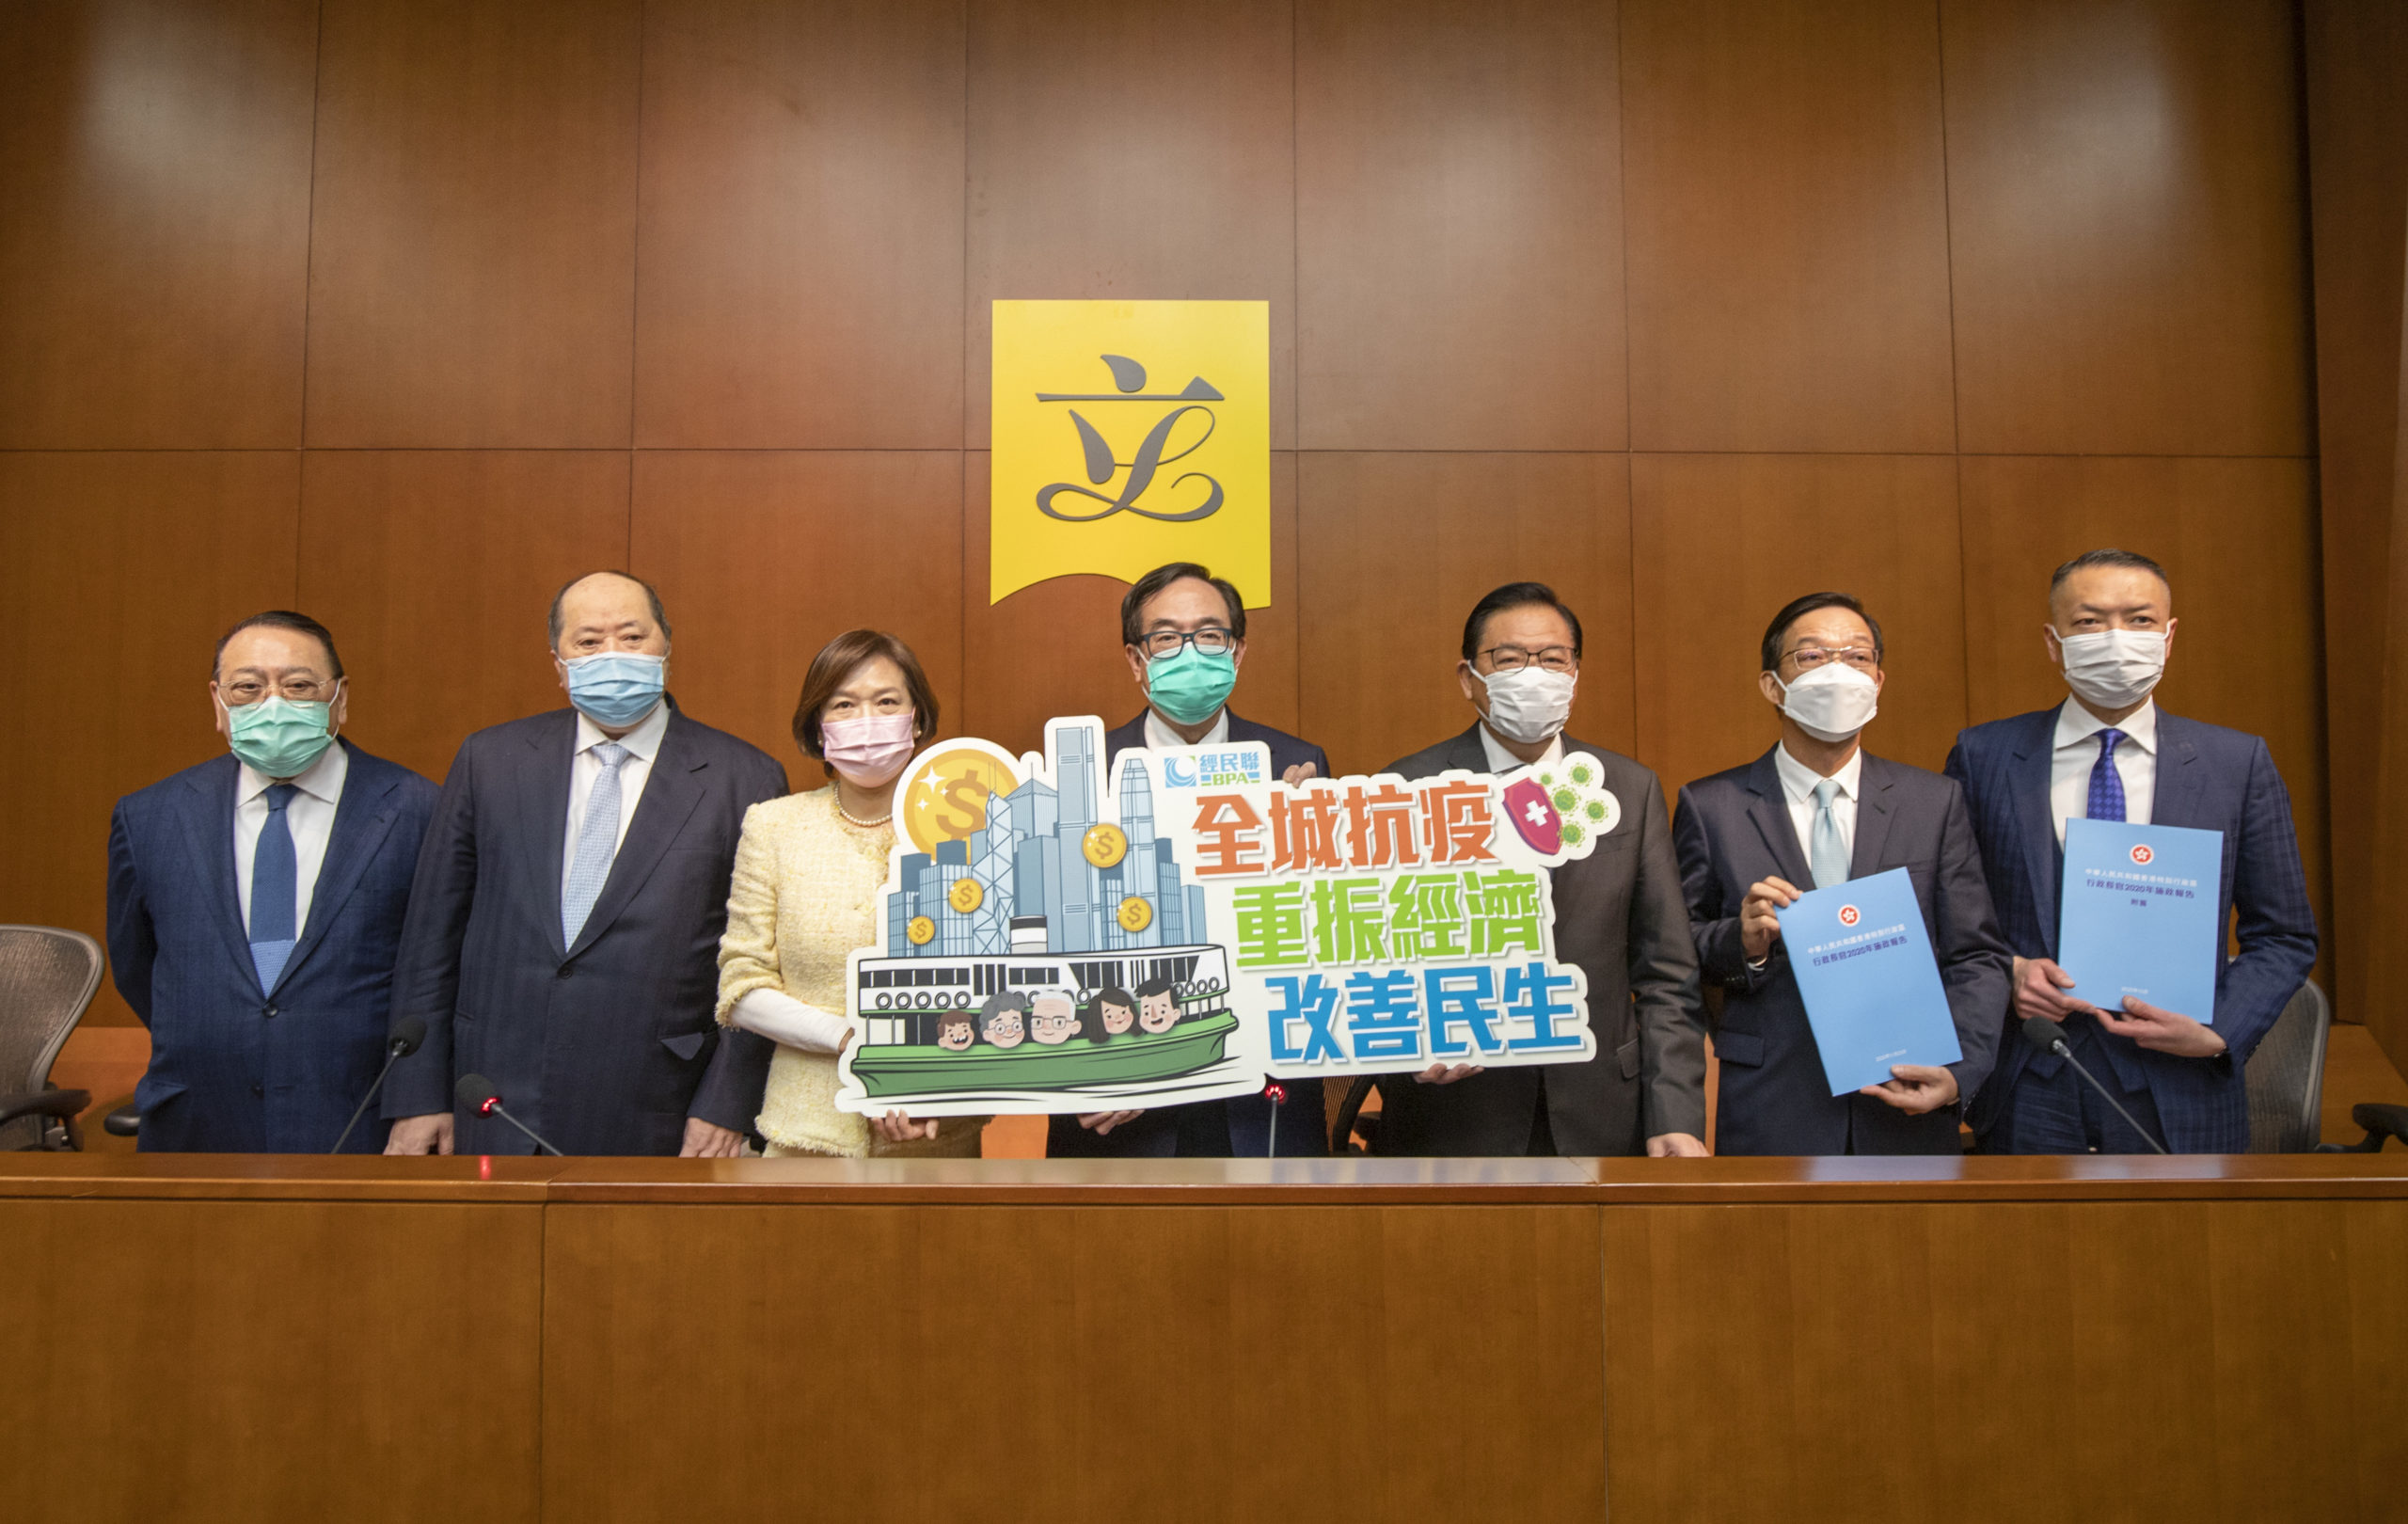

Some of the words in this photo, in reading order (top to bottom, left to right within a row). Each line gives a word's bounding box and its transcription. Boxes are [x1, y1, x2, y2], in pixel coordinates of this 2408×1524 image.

[1199, 752, 1260, 772] 經民聯
[1212, 772, 1249, 786] BPA
[1192, 781, 1502, 877] 全城抗疫
[1232, 868, 1545, 971] 重振經濟
[1264, 961, 1587, 1065] 改善民生
